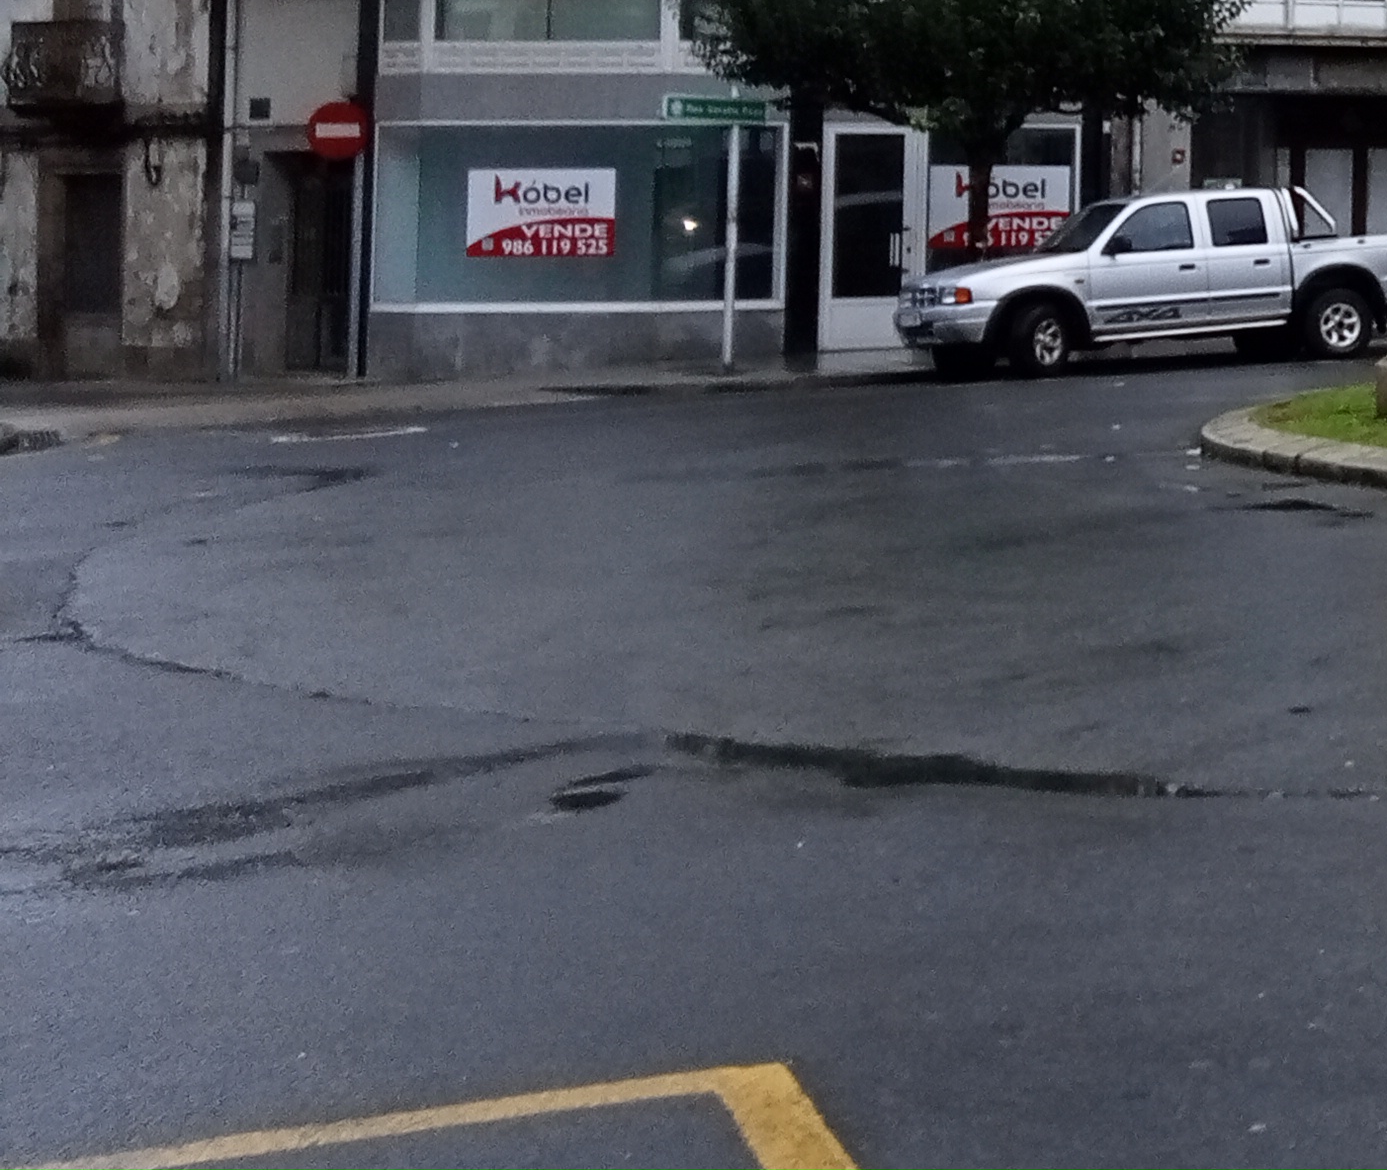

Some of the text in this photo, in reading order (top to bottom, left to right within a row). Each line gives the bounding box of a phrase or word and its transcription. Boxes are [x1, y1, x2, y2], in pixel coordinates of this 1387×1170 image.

[494, 173, 589, 204] Kóbel
[520, 223, 608, 238] VENDE
[501, 238, 608, 255] 986 119 525
[1000, 231, 1030, 247] 119
